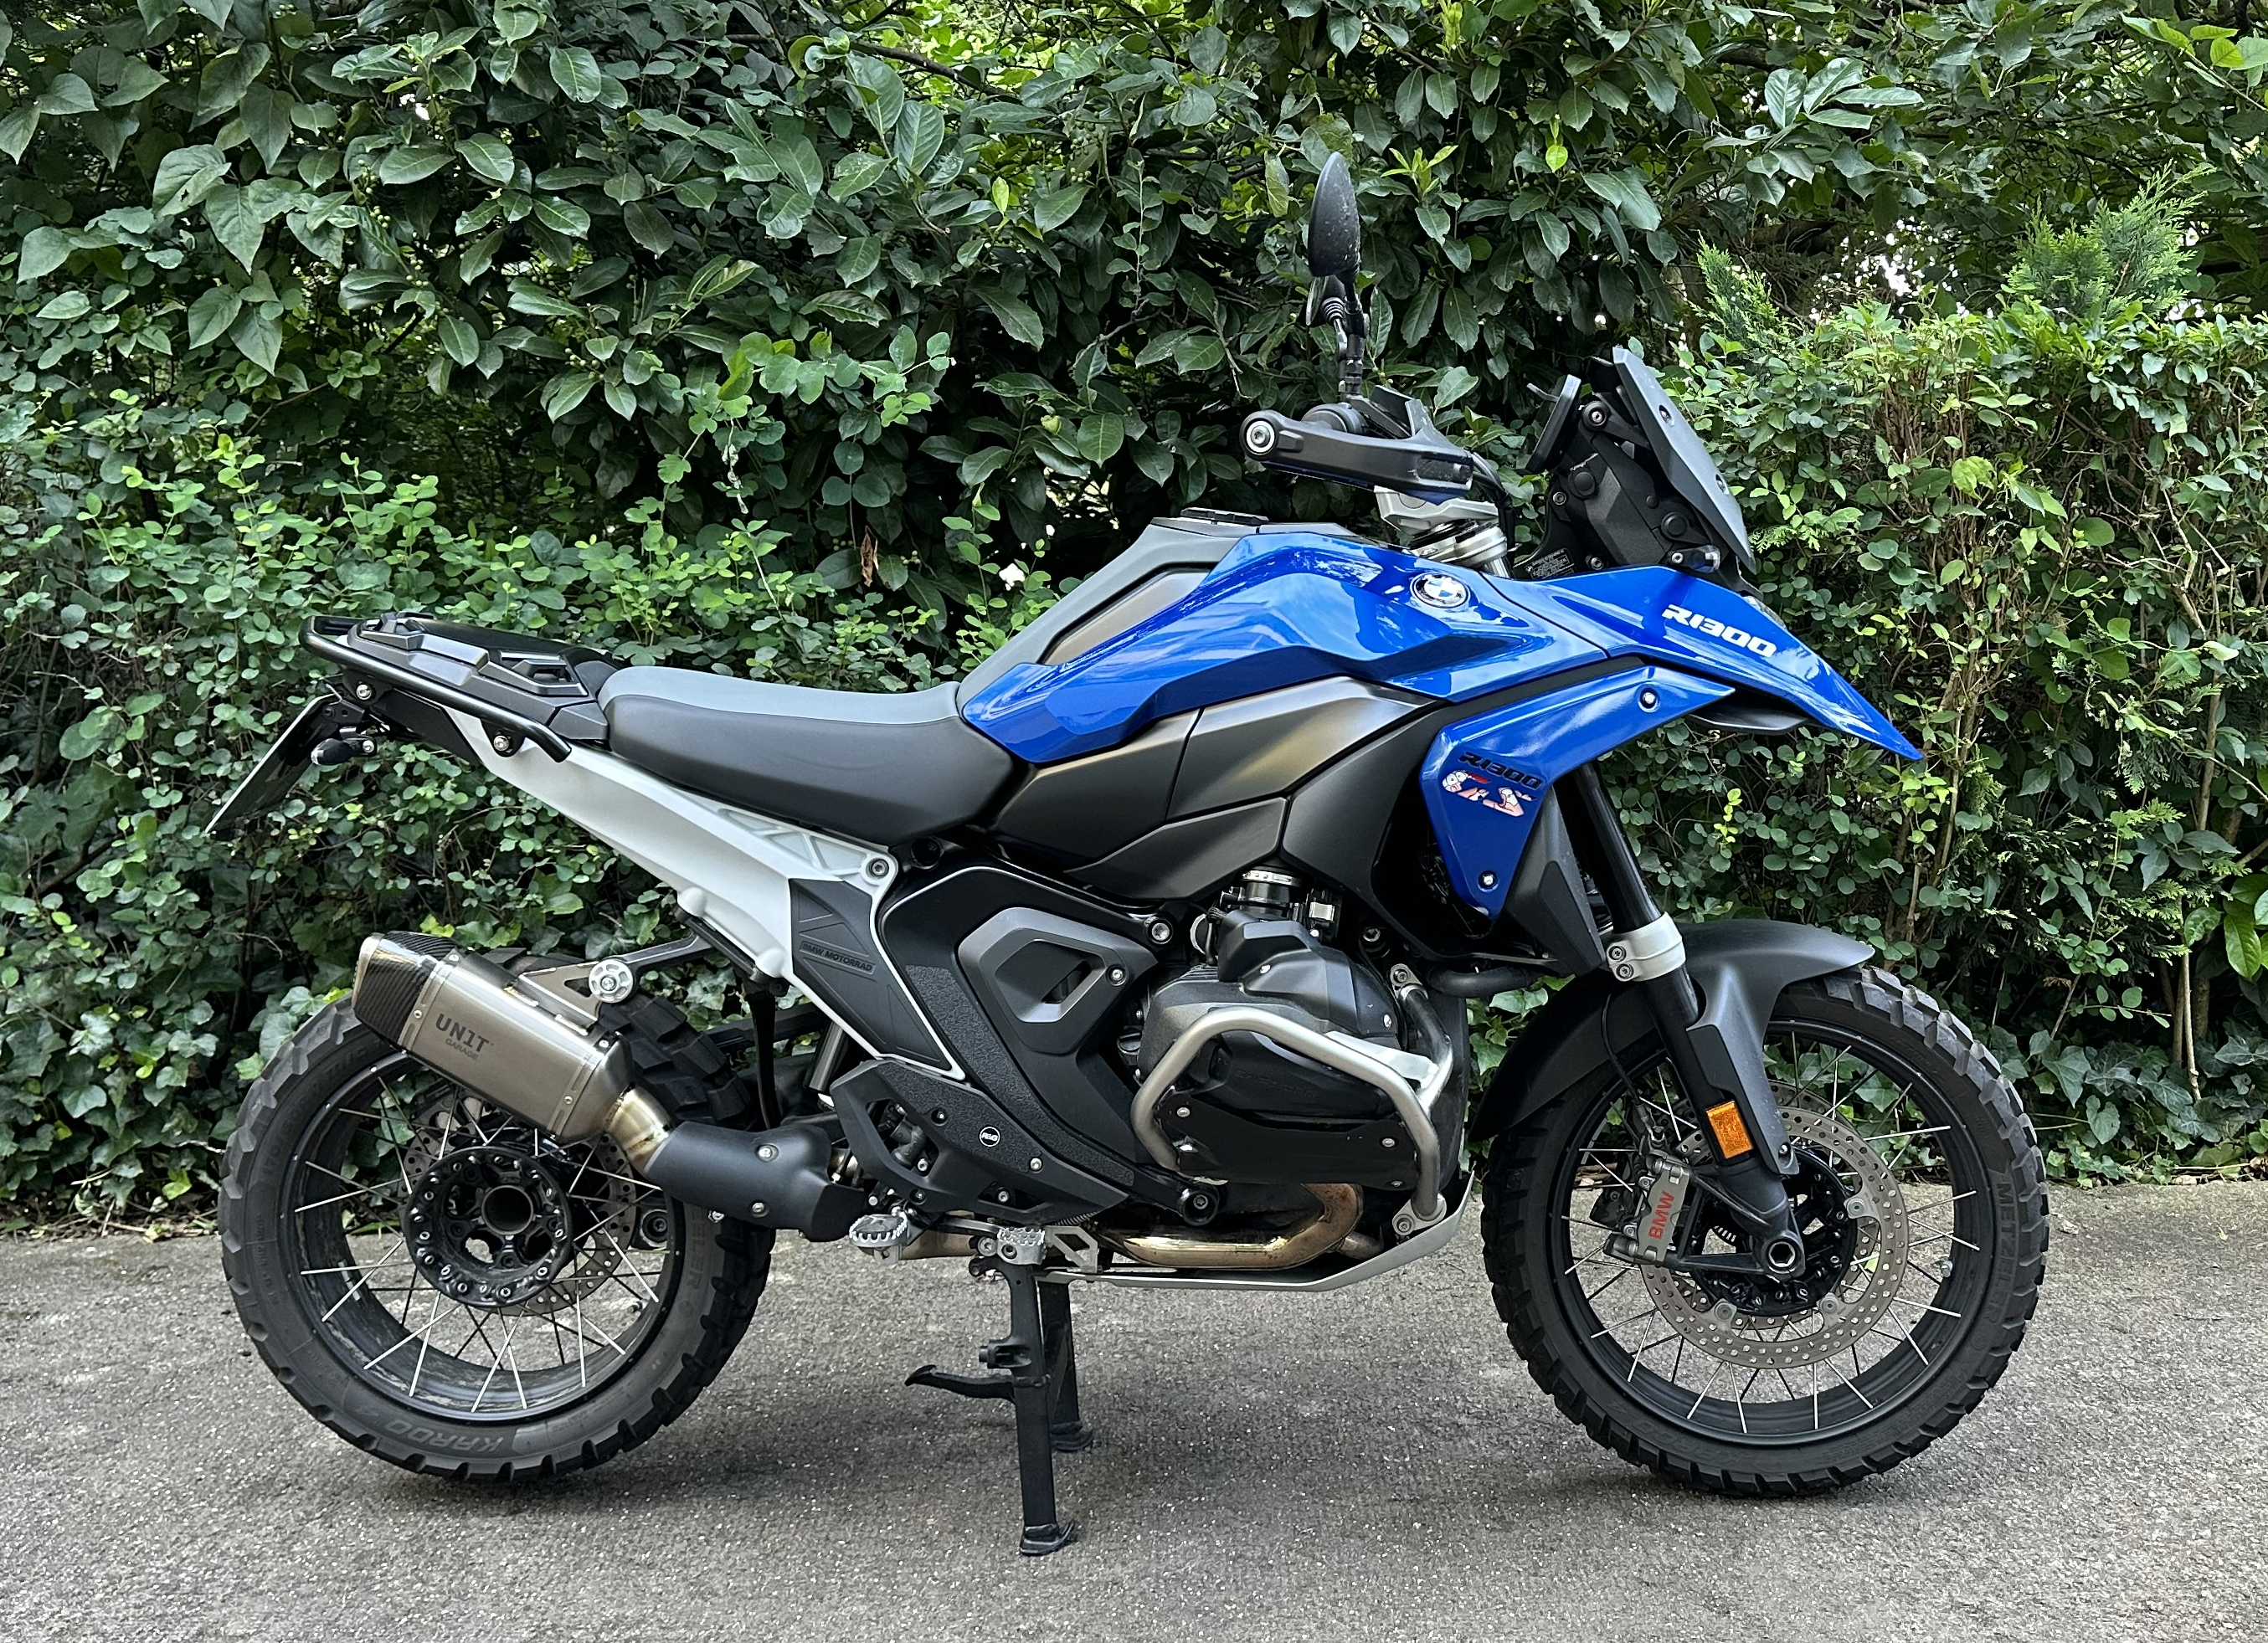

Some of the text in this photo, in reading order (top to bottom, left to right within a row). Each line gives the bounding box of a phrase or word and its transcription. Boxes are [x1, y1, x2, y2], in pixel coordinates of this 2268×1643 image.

[1661, 604, 1777, 658] R1300
[1458, 751, 1543, 791] R1300
[801, 942, 873, 971] BMW MOTORRAD
[445, 1038, 479, 1060] GARAGE
[1648, 1189, 1674, 1240] BMW
[1983, 1182, 2016, 1324] METZELER
[384, 1419, 504, 1452] KAROO
